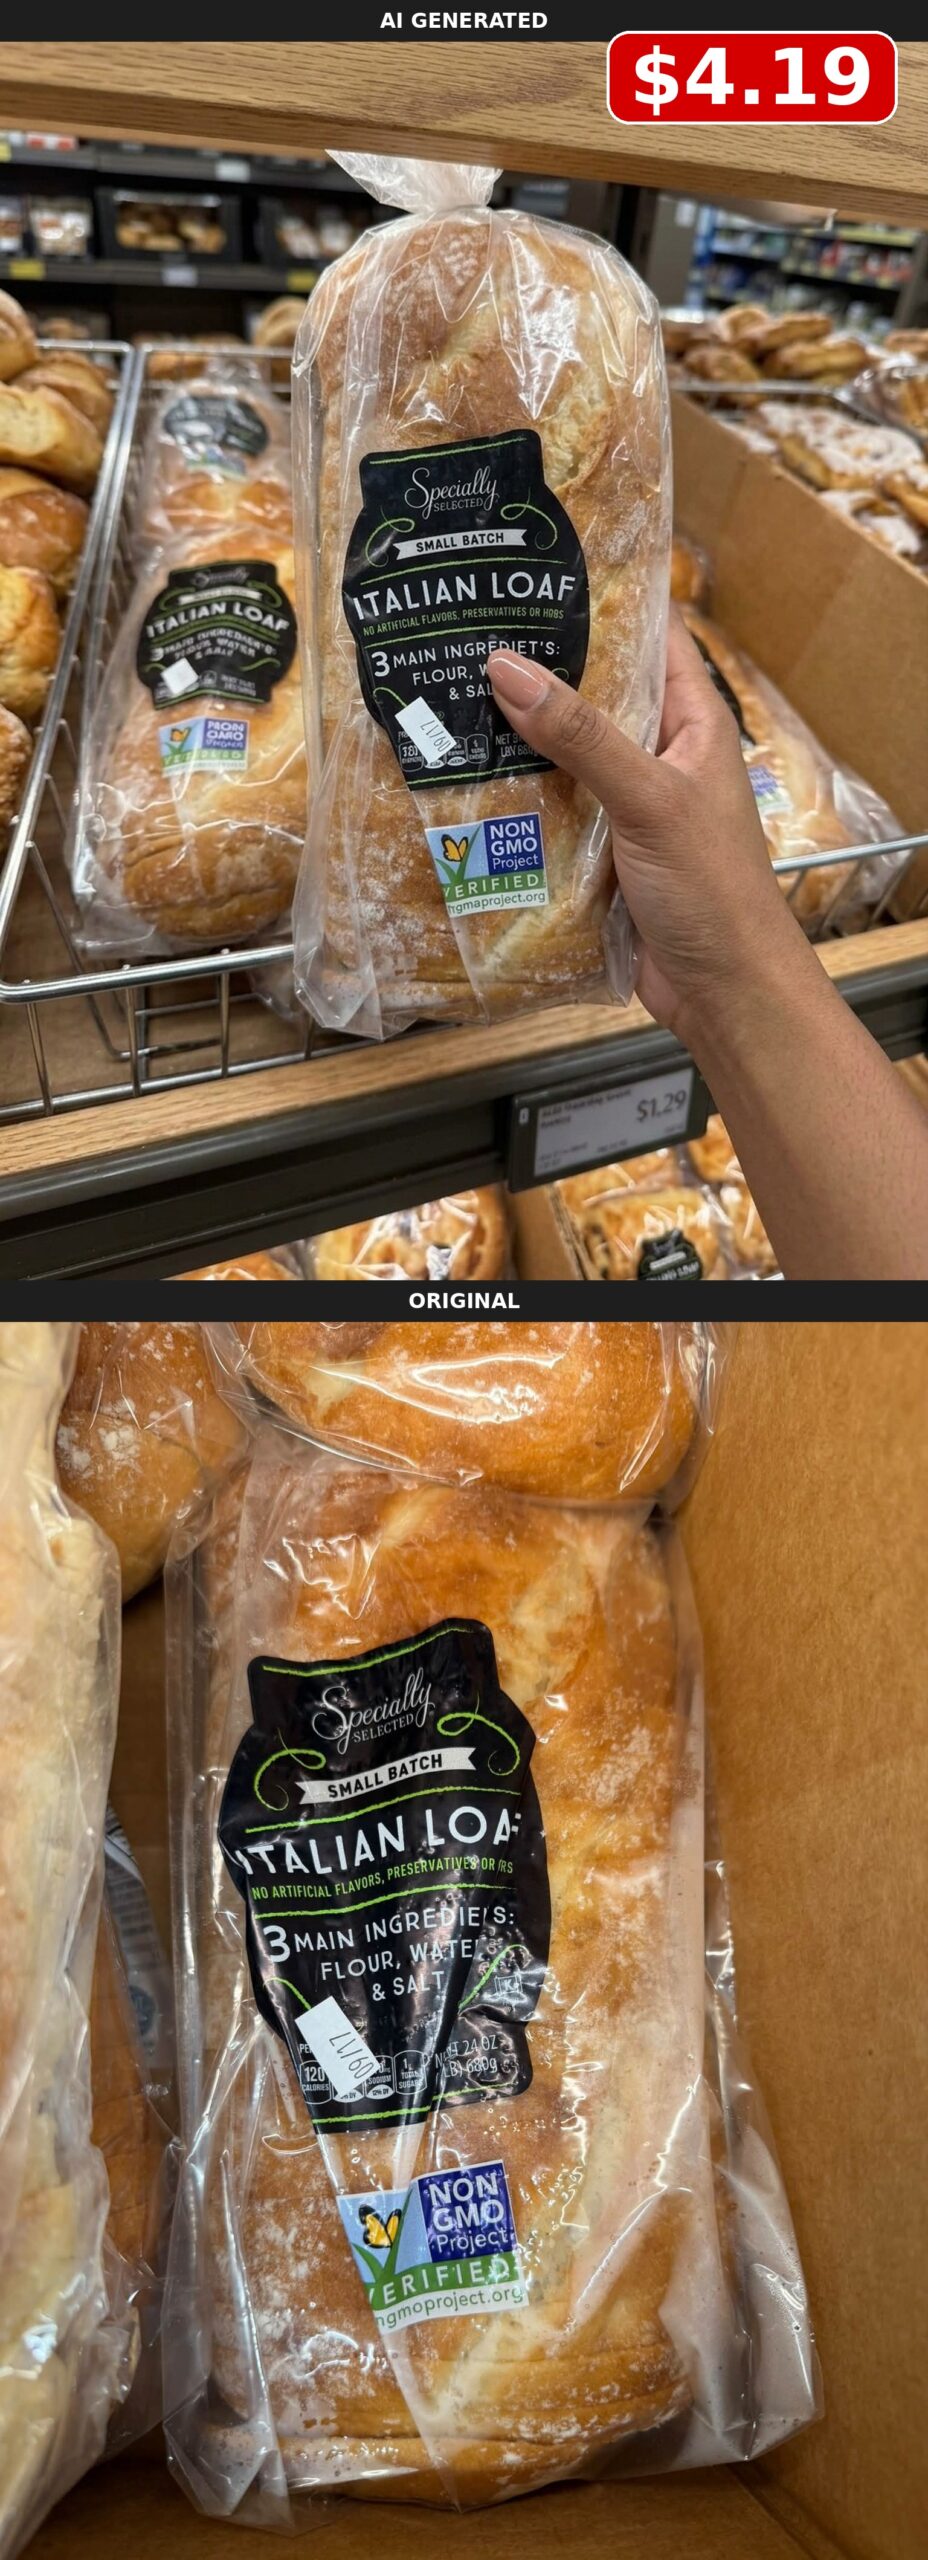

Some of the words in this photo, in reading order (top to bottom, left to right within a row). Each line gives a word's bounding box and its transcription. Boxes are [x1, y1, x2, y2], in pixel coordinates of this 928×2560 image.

[404, 465, 499, 519] Specially
[433, 498, 483, 512] SELECTED
[416, 535, 458, 552] SMALL
[463, 532, 504, 546] BATCH
[353, 573, 477, 620] ITALIAN
[491, 571, 576, 602] LOAF
[146, 602, 227, 639] ITALIAN
[232, 601, 290, 632] LOAF
[363, 626, 375, 637] NO
[462, 606, 527, 619] PRESERVATIVES
[529, 607, 541, 617] OR
[371, 651, 391, 677] 3
[393, 646, 437, 668] MAIN
[412, 665, 474, 686] FLOUR,
[449, 686, 460, 701] &
[466, 683, 494, 699] SAL
[489, 820, 536, 840] NON
[490, 837, 538, 857] GMO
[492, 854, 539, 870] Project
[636, 1089, 687, 1124] $1.29
[312, 1667, 435, 1755] Specially
[353, 1713, 415, 1744] SELECTED
[328, 1773, 383, 1799] SMALL
[388, 1753, 443, 1781] BATCH
[236, 1815, 406, 1875] ITALIAN
[252, 1886, 269, 1900] NO
[272, 1881, 332, 1899] ARTIFICIAL
[335, 1872, 385, 1897] FLAVORS,
[387, 1856, 478, 1879] PRESERVATIVES
[480, 1857, 495, 1871] OR
[263, 1924, 291, 1963] 3
[294, 1928, 355, 1953] MAIN
[321, 1951, 402, 1981] FLOUR,
[410, 1938, 478, 1965] WATE
[372, 1983, 386, 2002] &
[393, 1970, 446, 1997] SALT
[299, 2043, 312, 2054] PE
[462, 2037, 479, 2055] 24
[301, 2083, 330, 2092] CALORIES
[303, 2066, 326, 2082] 120
[368, 2074, 392, 2085] SODIUM
[428, 2172, 500, 2207] NON
[432, 2198, 505, 2232] GMO
[436, 2227, 510, 2255] Project
